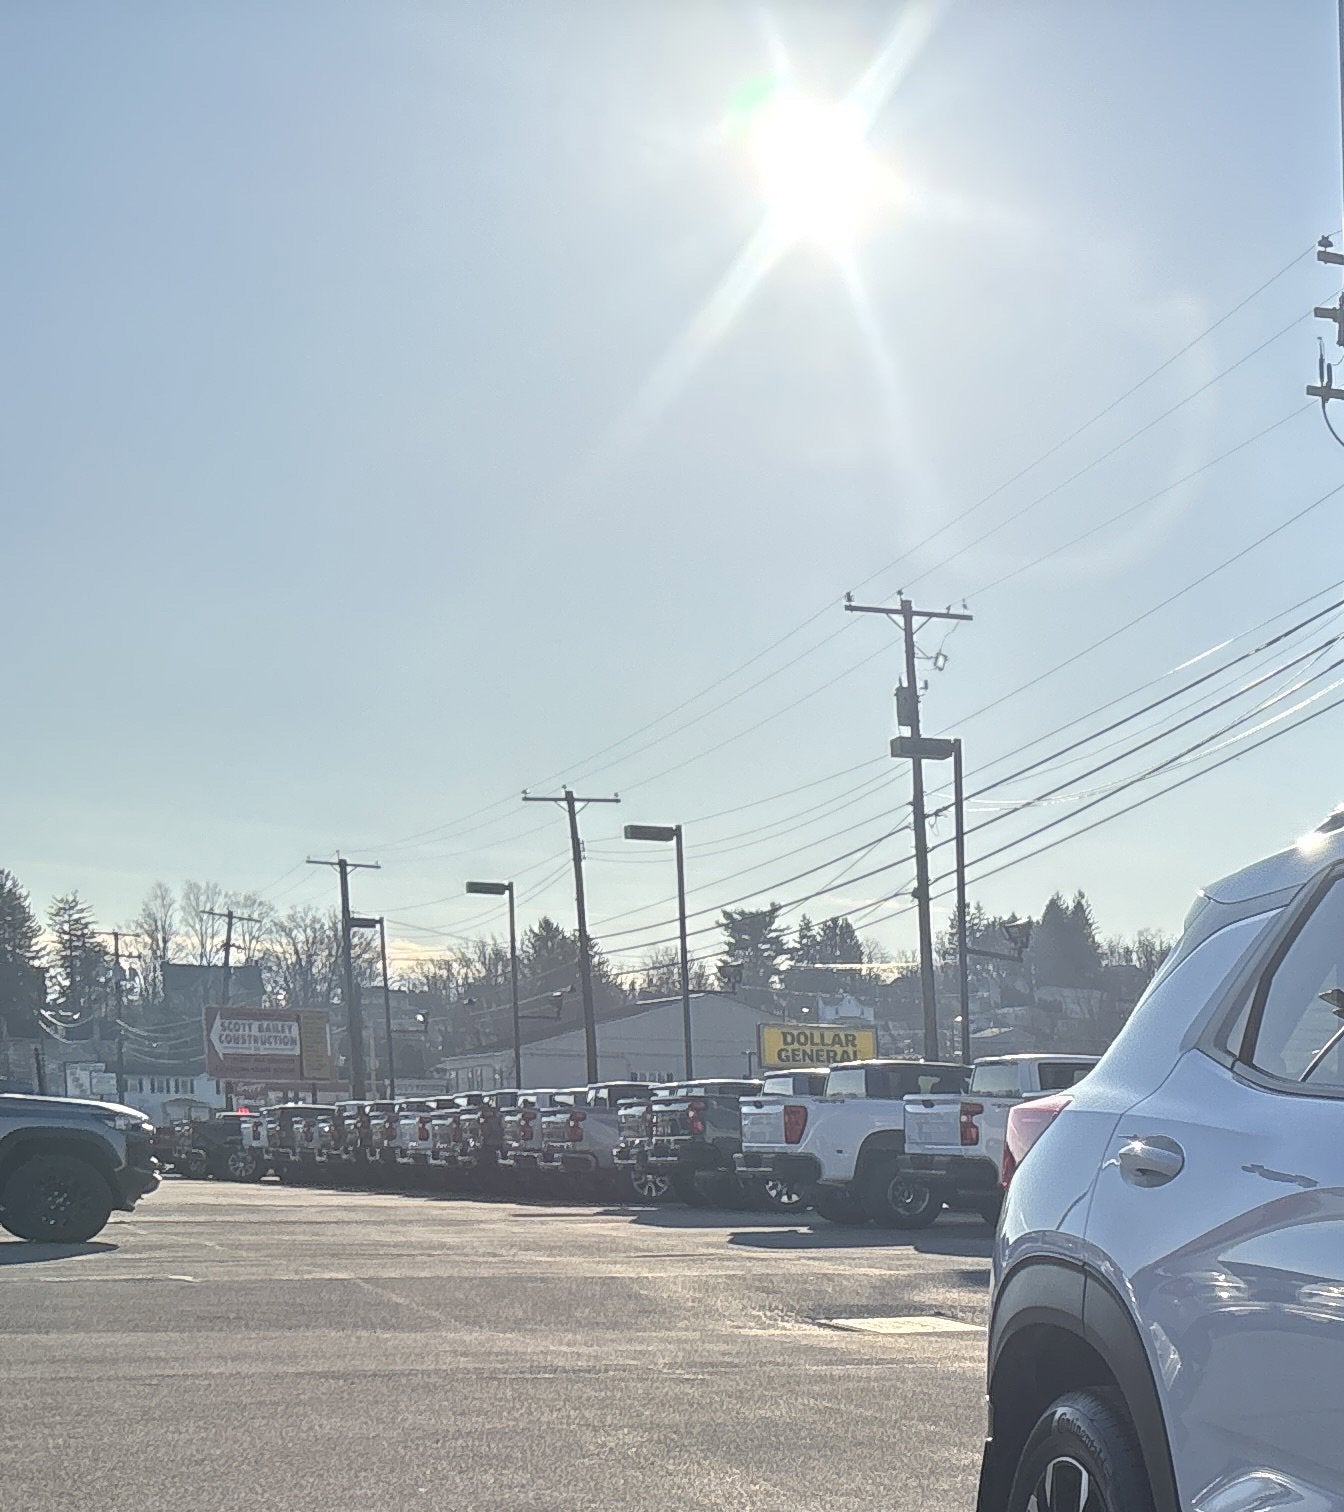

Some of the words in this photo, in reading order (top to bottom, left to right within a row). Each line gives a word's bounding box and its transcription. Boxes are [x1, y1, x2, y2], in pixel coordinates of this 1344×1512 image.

[221, 1021, 252, 1033] SCOTT
[257, 1022, 293, 1034] BAILEY
[219, 1034, 298, 1046] CONSTRUCTION
[781, 1031, 857, 1047] DOLLAR
[777, 1048, 859, 1063] GENERAL
